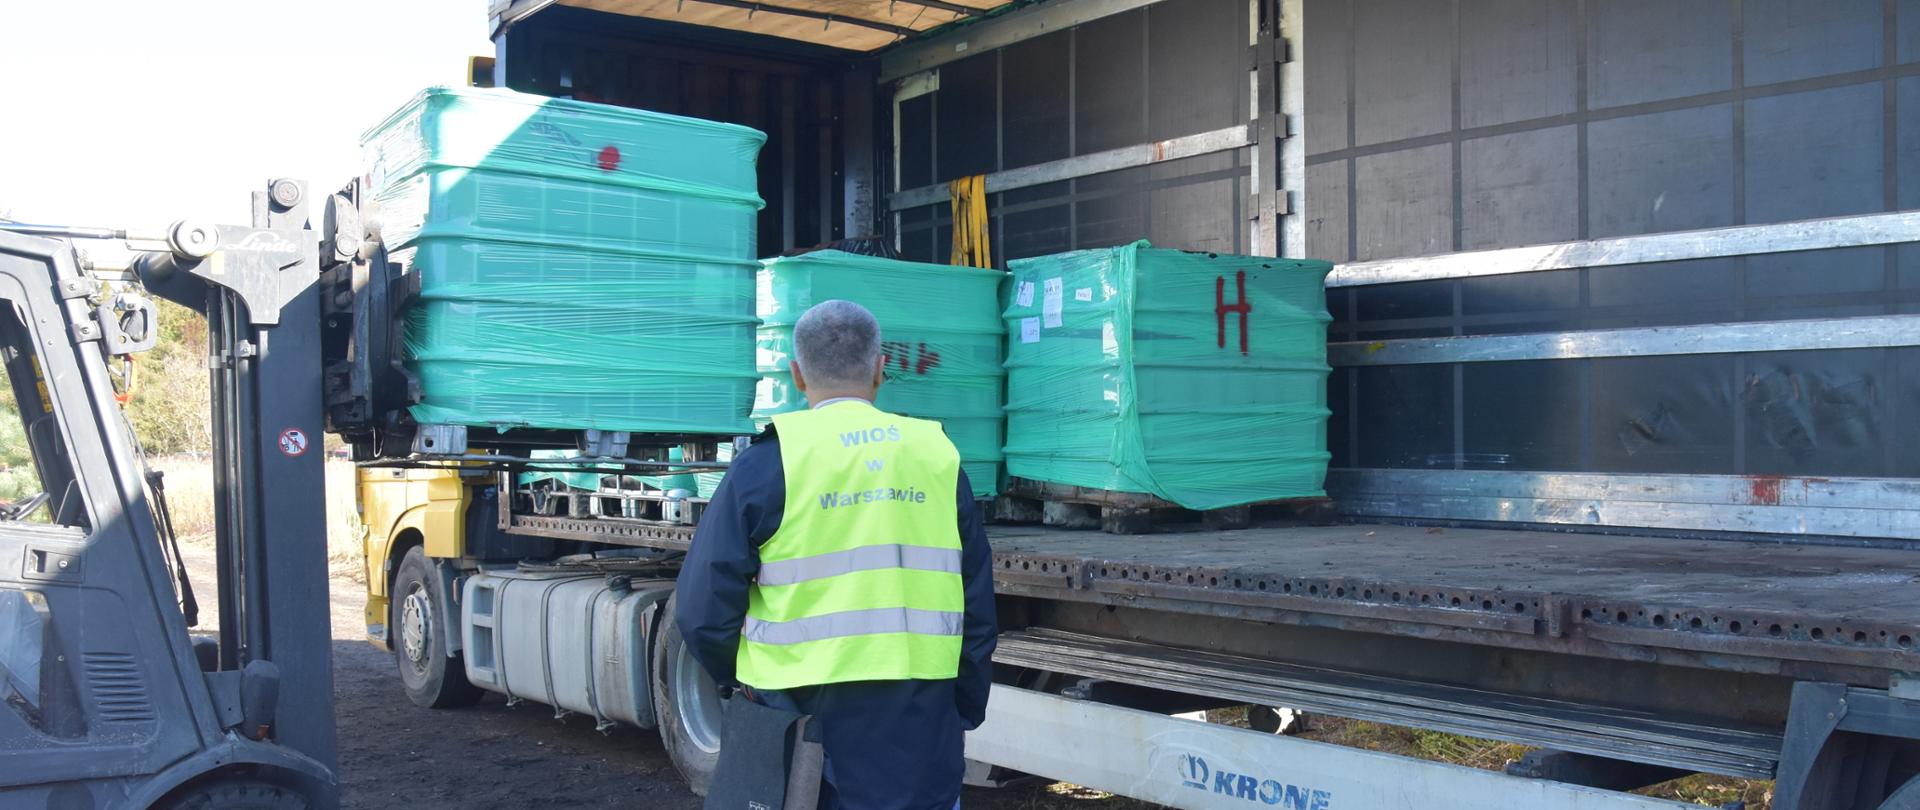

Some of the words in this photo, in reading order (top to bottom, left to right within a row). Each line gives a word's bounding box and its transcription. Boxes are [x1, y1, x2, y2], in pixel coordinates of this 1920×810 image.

[224, 231, 297, 253] Linde
[1215, 270, 1252, 357] H
[840, 425, 901, 447] WIOŚ
[819, 487, 926, 510] Warszawie
[1214, 771, 1331, 810] KRONE
